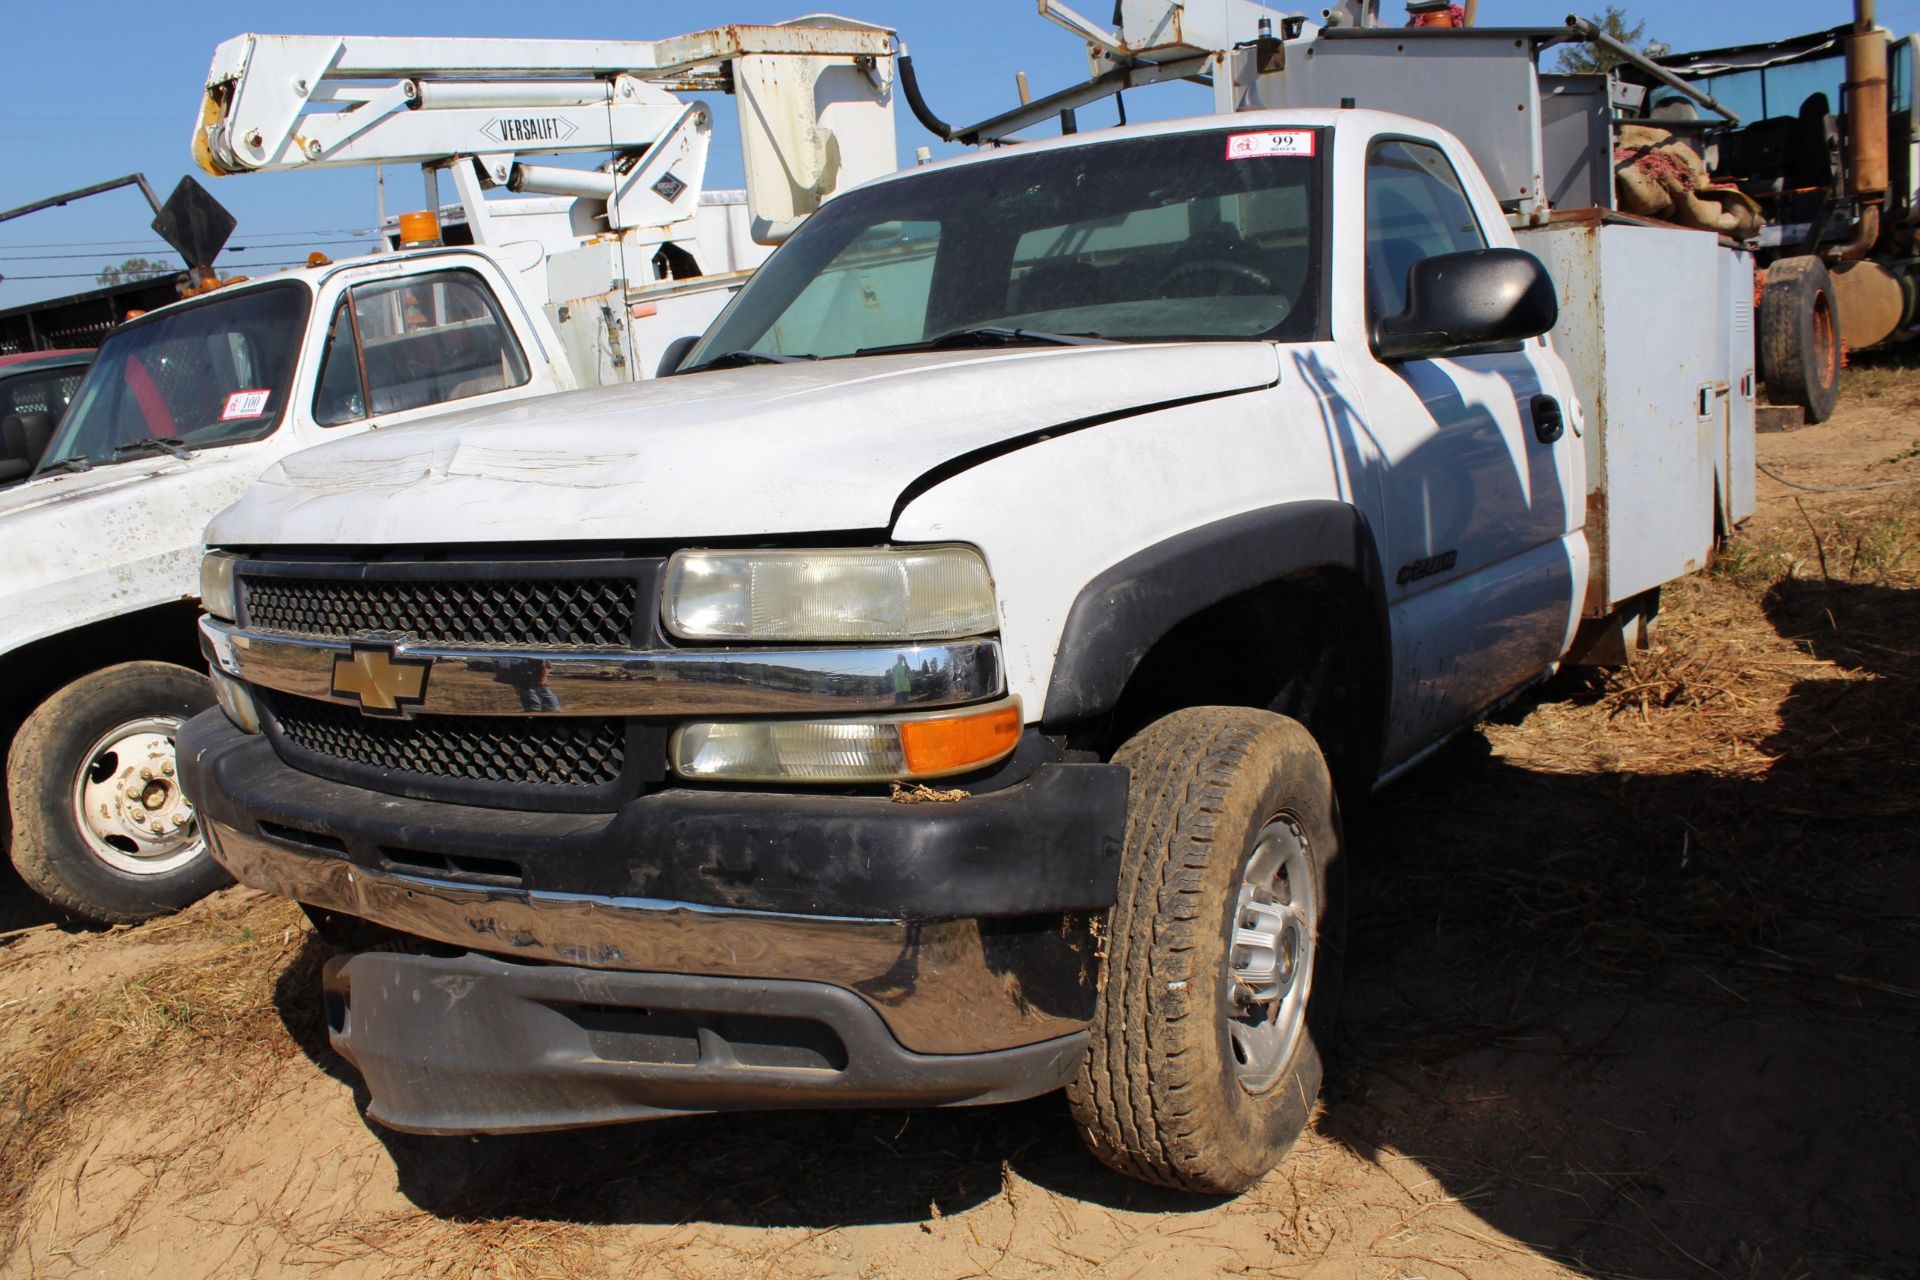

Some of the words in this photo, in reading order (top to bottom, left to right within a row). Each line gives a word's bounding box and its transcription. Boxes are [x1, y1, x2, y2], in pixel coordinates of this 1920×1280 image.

[500, 118, 559, 141] VERSALIFT
[1272, 135, 1294, 147] 99
[243, 395, 261, 409] 100
